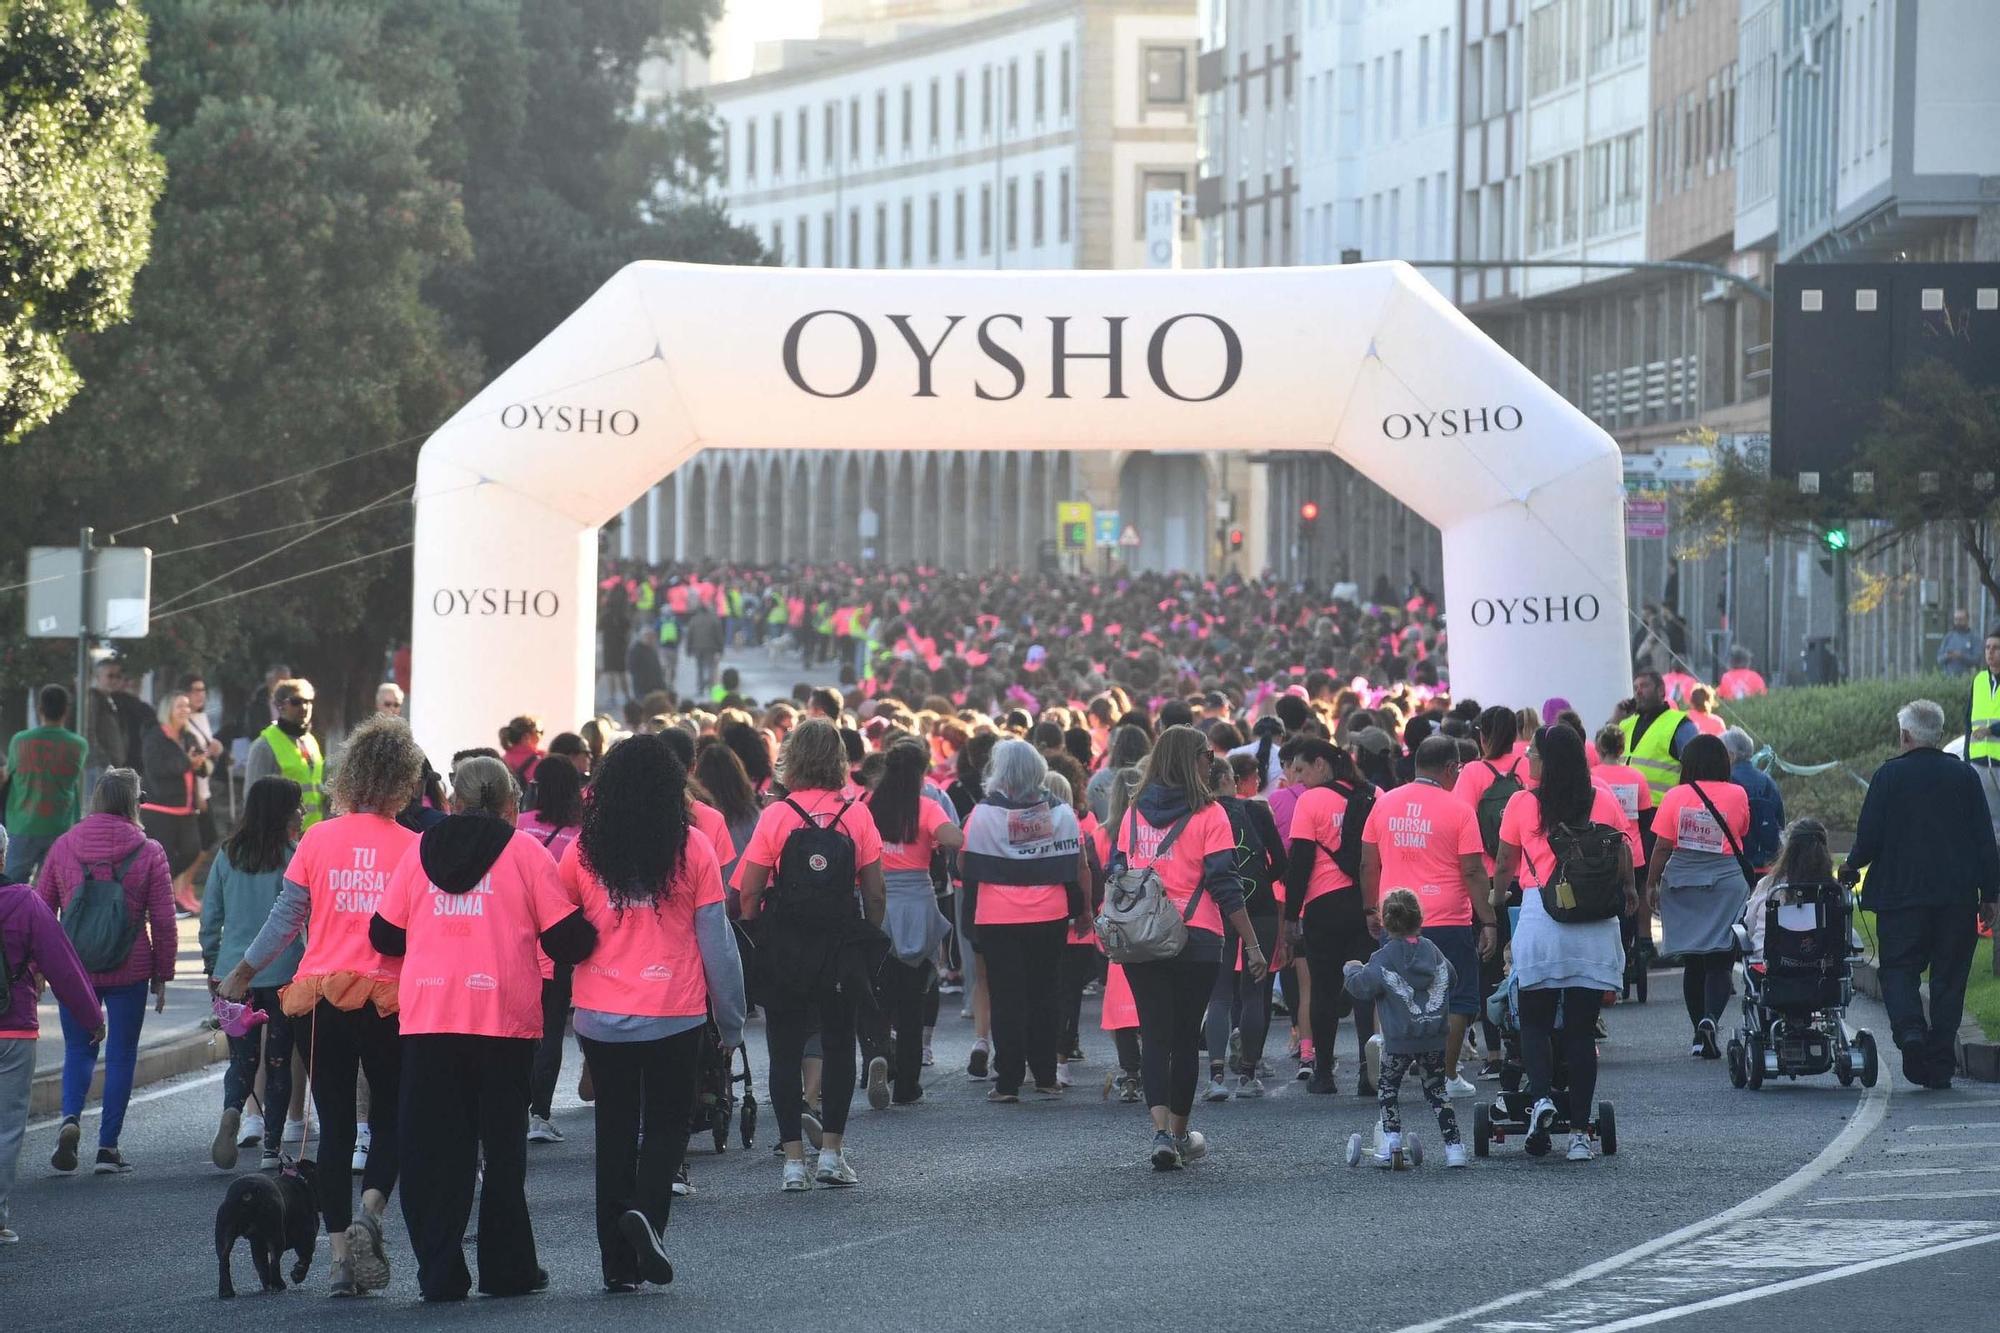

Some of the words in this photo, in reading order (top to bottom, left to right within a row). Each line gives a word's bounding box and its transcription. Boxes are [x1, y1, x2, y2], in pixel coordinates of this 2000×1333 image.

[782, 310, 1243, 402] OYSHO
[501, 404, 638, 437] OYSHO
[1383, 404, 1523, 440] OYSHO
[433, 588, 559, 617] OYSHO
[1471, 594, 1599, 627] OYSHO
[1407, 803, 1422, 817] TU
[1389, 817, 1433, 834] DORSAL
[1053, 839, 1079, 852] WITH
[1394, 834, 1426, 848] SUMA
[353, 847, 376, 868] TU
[329, 869, 391, 892] DORSA
[433, 895, 484, 916] SUMA
[441, 921, 472, 937] 2025
